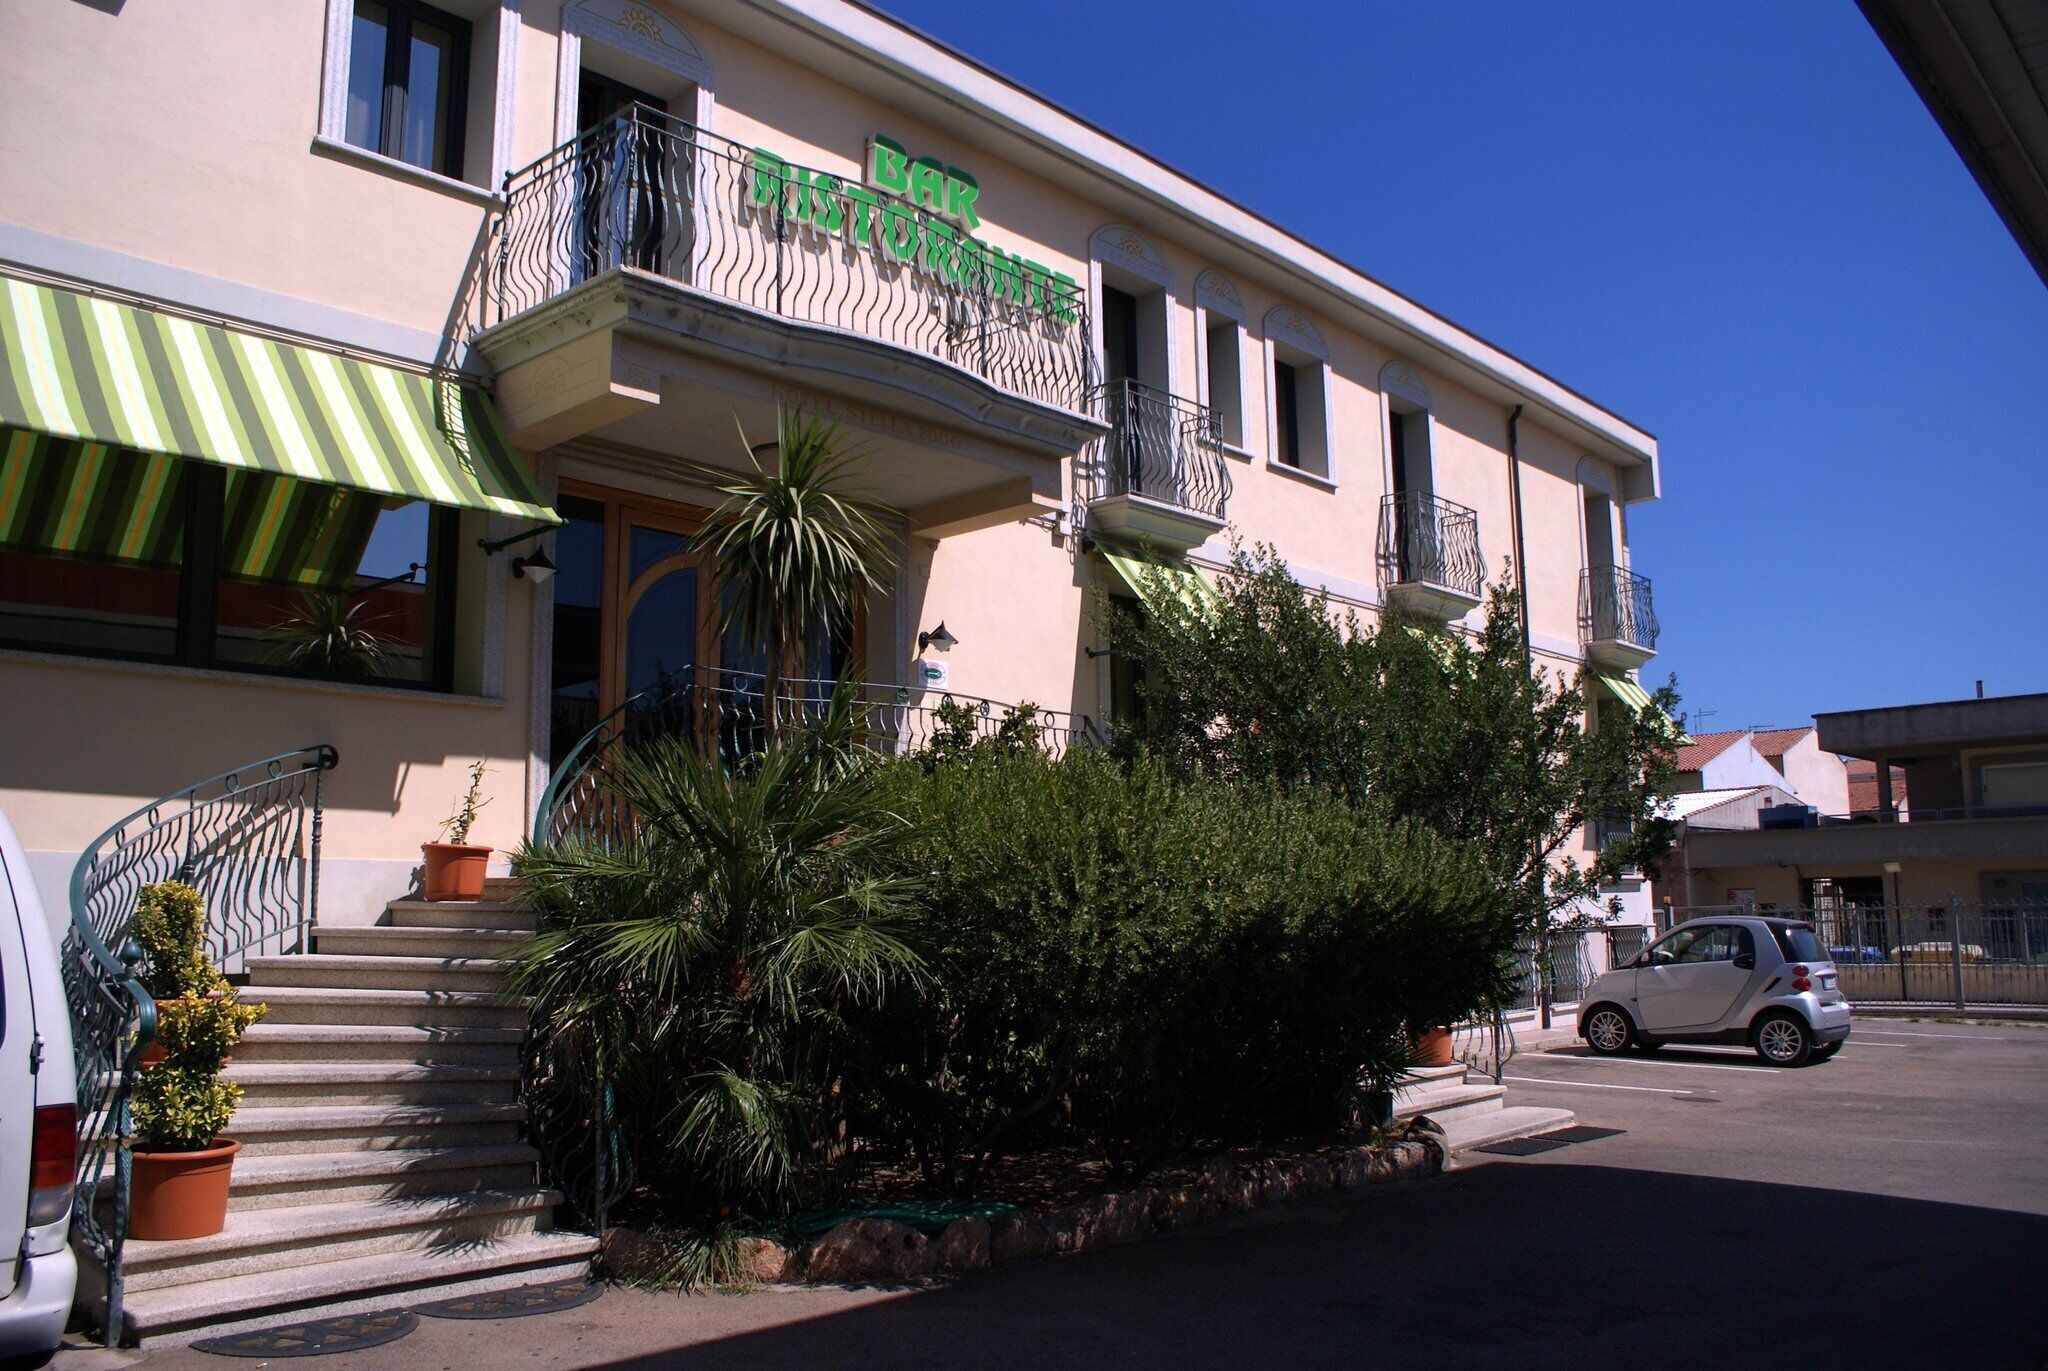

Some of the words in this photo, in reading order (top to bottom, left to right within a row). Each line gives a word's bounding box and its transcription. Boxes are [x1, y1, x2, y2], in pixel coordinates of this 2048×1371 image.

[868, 133, 981, 230] BAR
[751, 146, 1078, 325] RISTORANTE
[770, 382, 838, 416] HOTEL
[845, 403, 914, 436] STELLA
[919, 424, 962, 450] 2000
